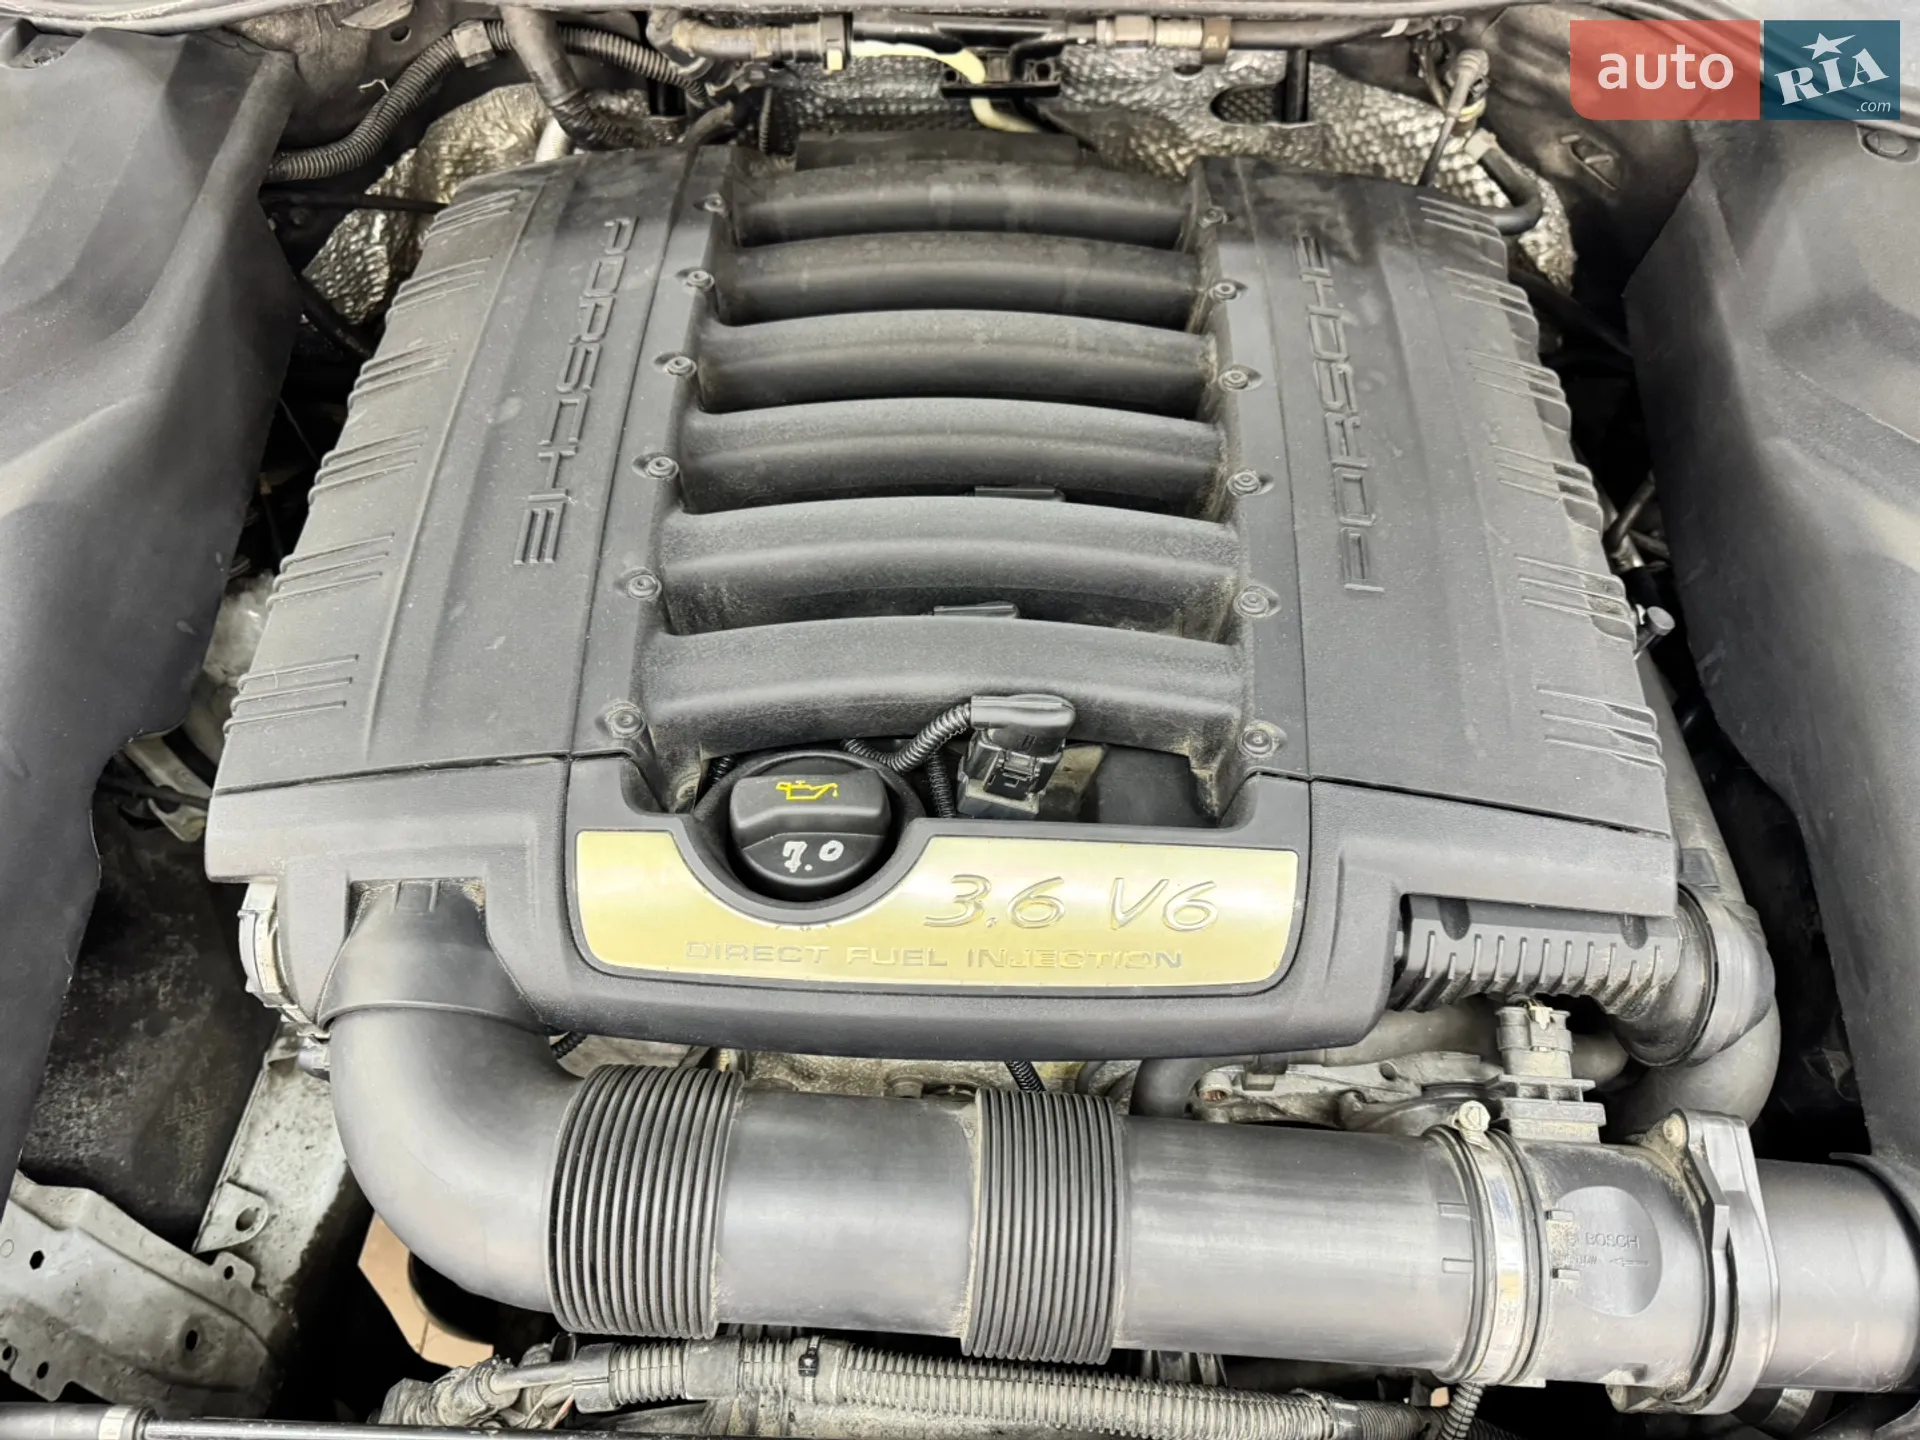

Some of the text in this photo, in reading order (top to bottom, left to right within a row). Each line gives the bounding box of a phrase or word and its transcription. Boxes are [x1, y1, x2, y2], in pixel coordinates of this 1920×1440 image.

[512, 215, 639, 566] PORSCHE
[1293, 234, 1385, 593] PORSCHE
[923, 874, 1218, 932] 3.6 V6
[685, 940, 1183, 969] DIRECT FUEL INJECTION
[1585, 1231, 1639, 1248] BOSCH
